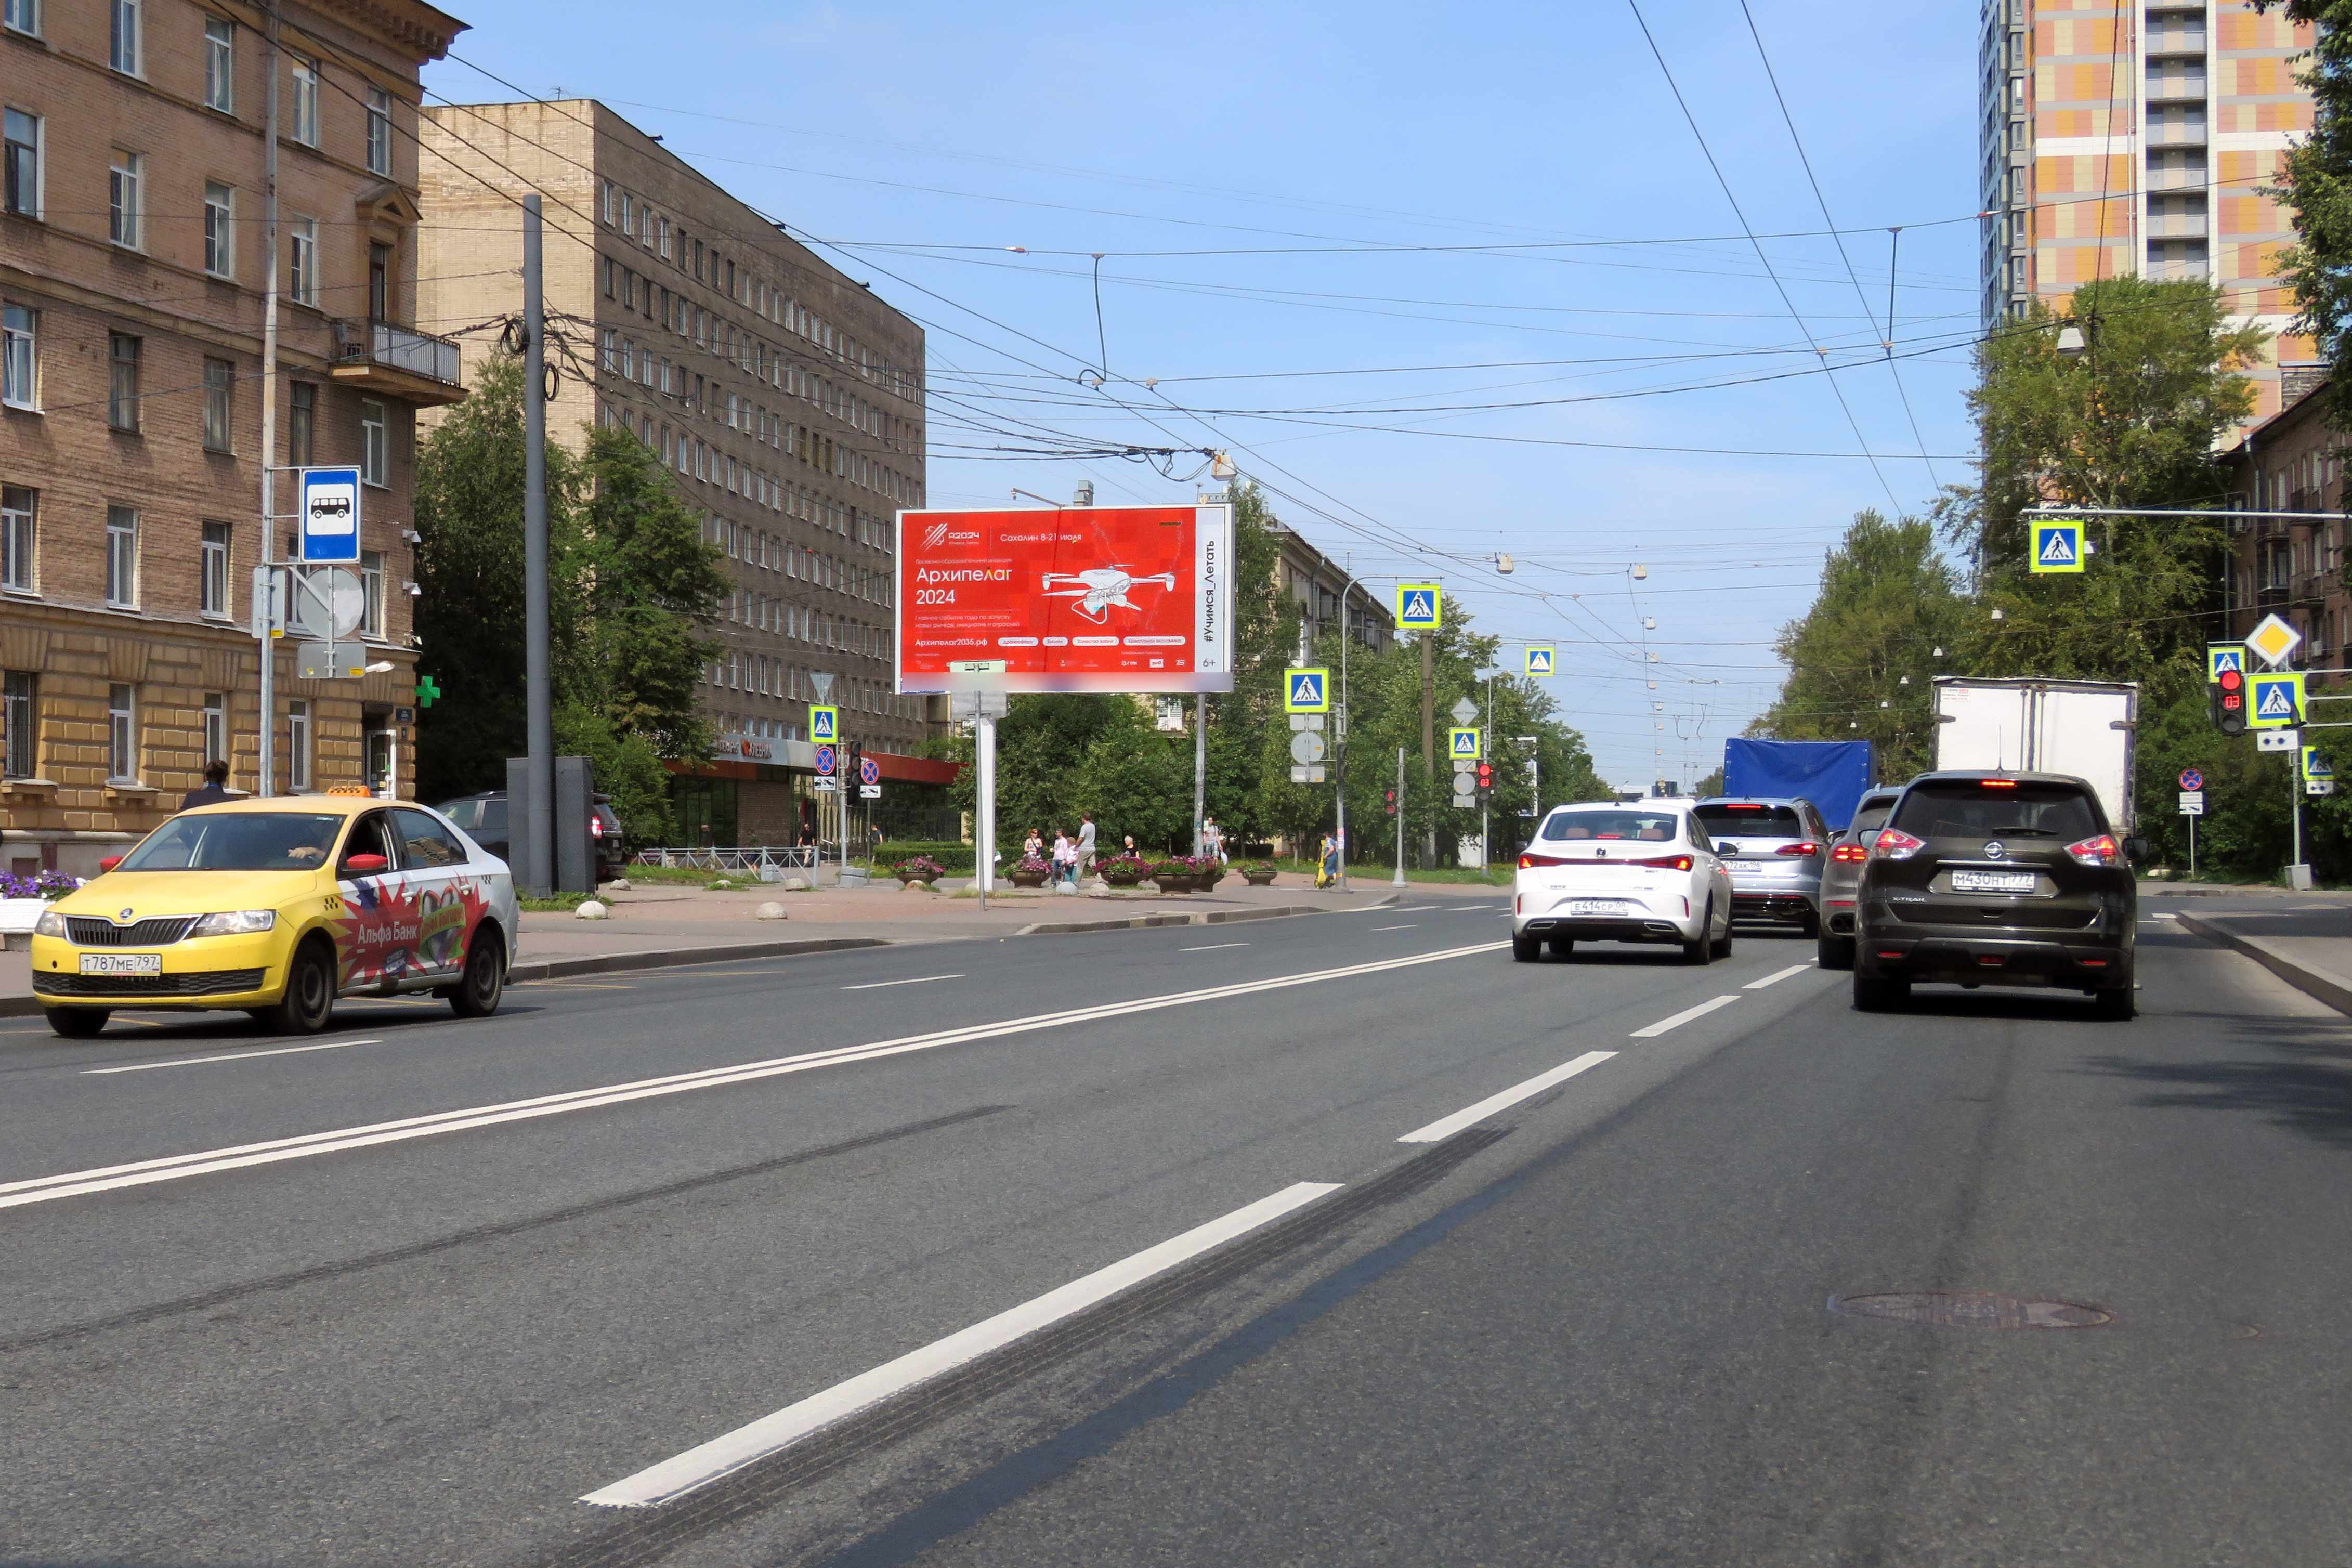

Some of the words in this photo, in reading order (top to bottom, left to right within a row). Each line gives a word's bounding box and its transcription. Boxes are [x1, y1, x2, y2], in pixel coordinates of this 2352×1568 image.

[916, 568, 1012, 585] Архипелаг
[916, 589, 956, 604] 2024
[1204, 540, 1216, 642] #Учимся_Летать
[915, 638, 988, 648] Архипелаг2035.рф
[1203, 658, 1216, 668] 6+
[2226, 695, 2240, 708] 03
[2011, 873, 2031, 883] 777
[358, 923, 391, 947] Альфа
[393, 921, 418, 941] Банк
[84, 956, 133, 971] Т787МЕ
[136, 956, 157, 967] 797
